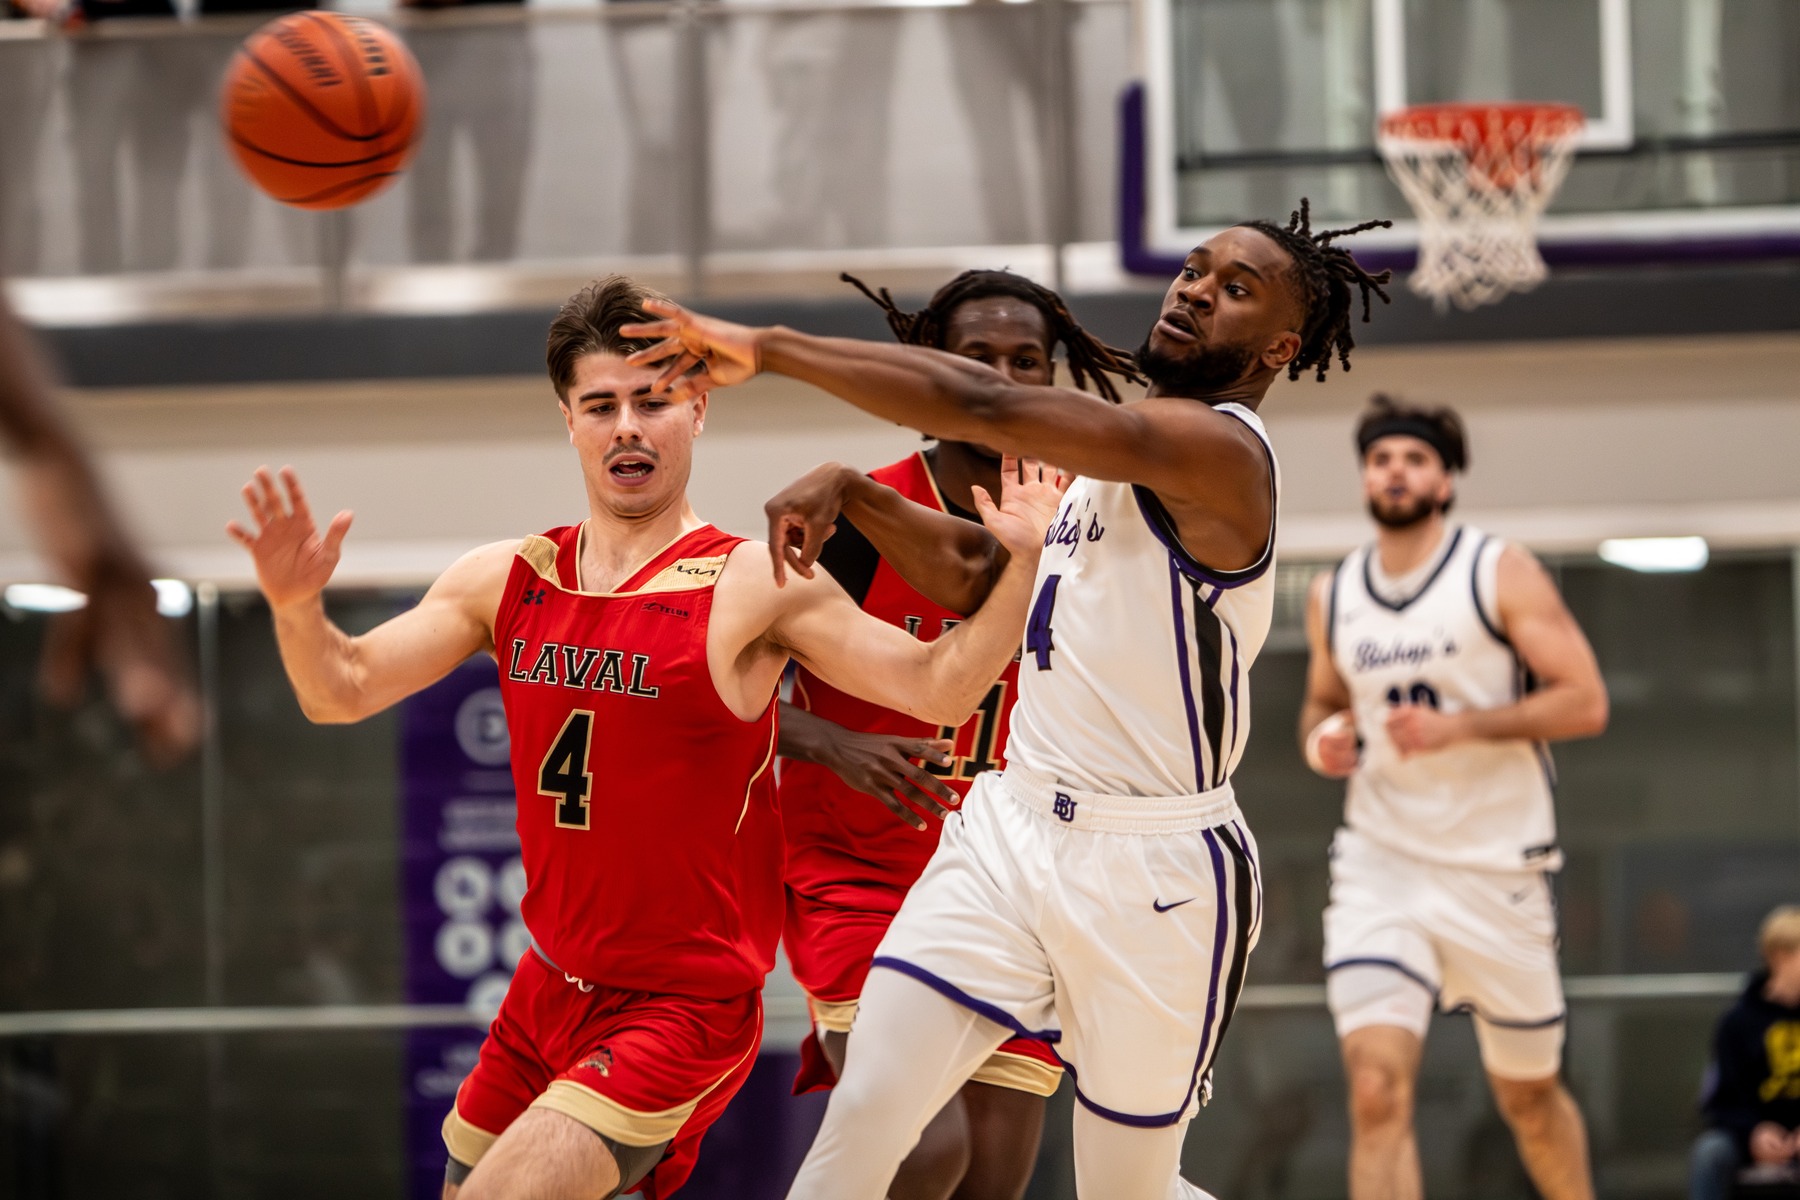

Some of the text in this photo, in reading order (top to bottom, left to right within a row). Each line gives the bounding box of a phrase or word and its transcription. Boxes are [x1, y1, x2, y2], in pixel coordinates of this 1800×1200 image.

[660, 605, 689, 617] TELUS
[1026, 574, 1062, 671] 4
[508, 638, 660, 699] LAVAL
[537, 708, 595, 831] 4
